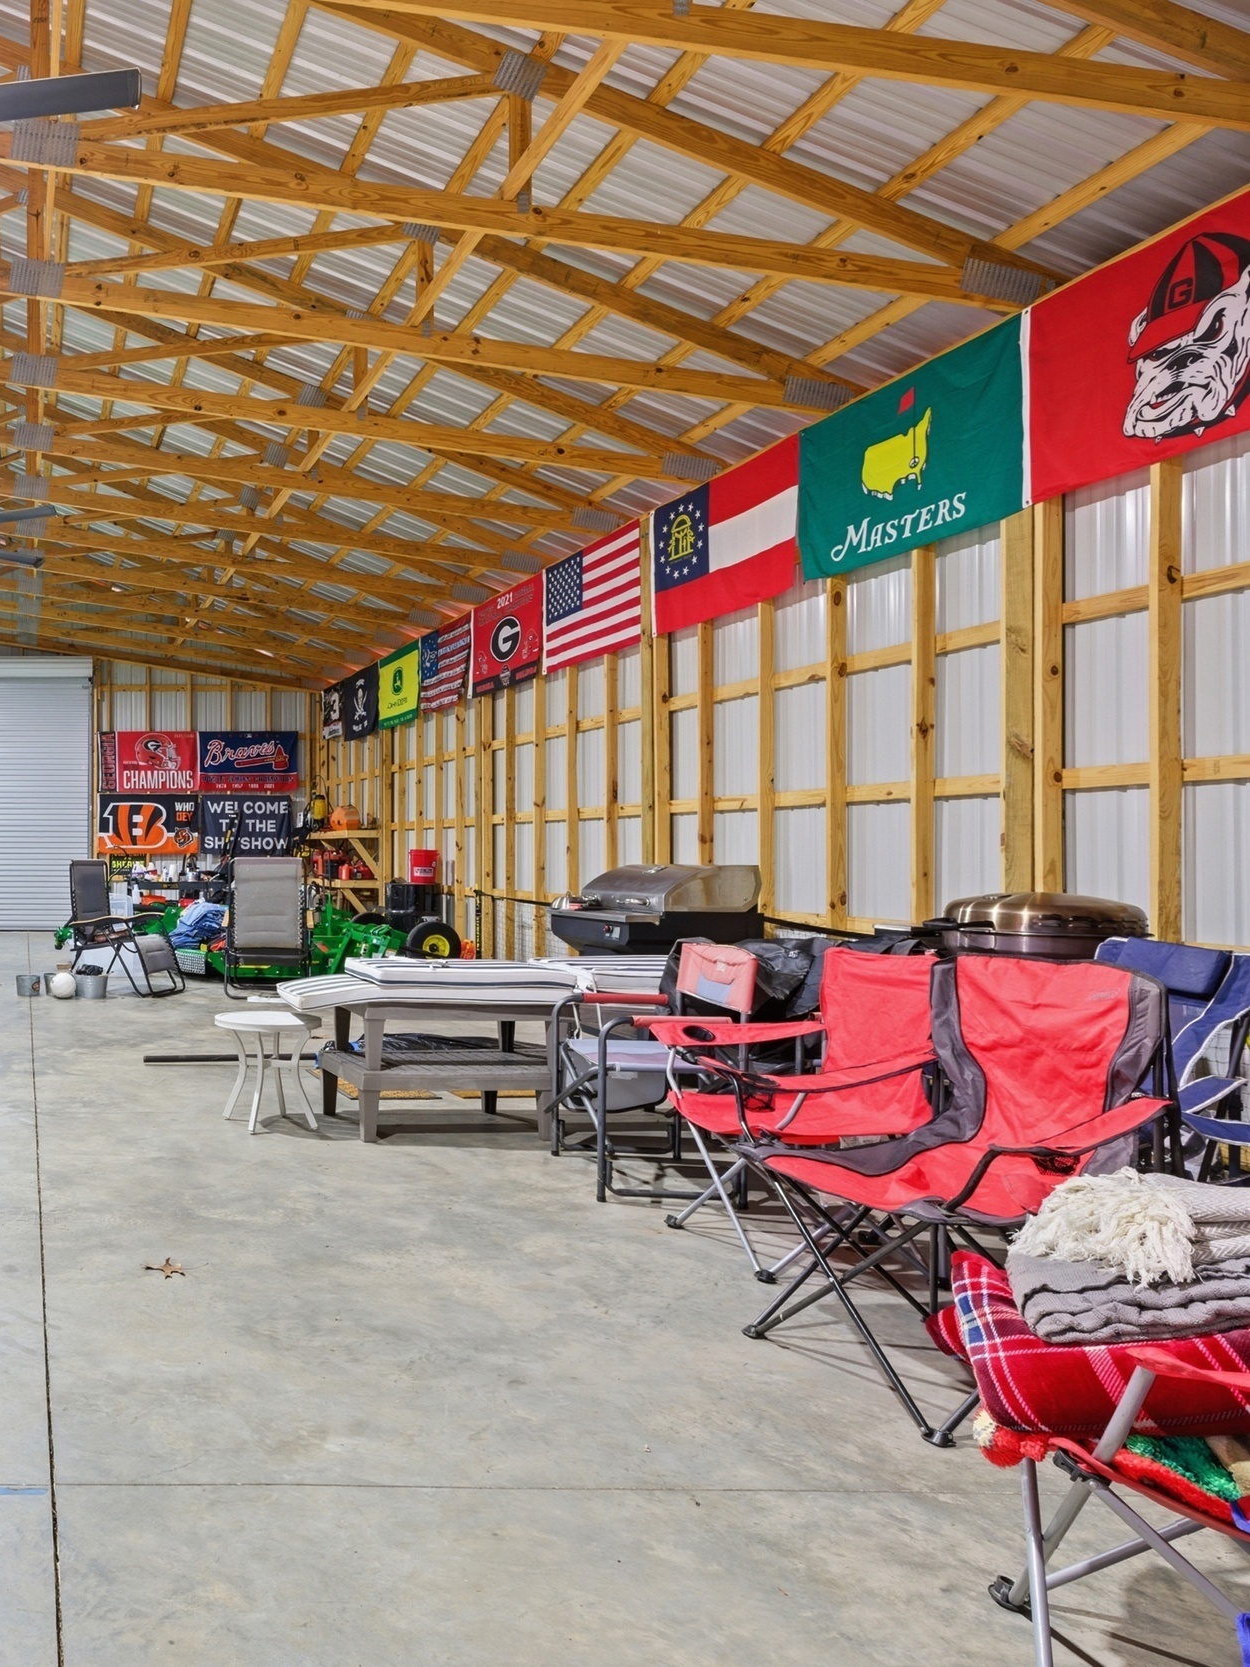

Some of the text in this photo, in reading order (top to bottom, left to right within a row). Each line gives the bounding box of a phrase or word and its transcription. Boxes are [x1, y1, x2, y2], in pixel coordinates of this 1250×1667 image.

[1167, 277, 1194, 309] G
[831, 492, 967, 562] MASTERS
[497, 592, 513, 609] 2021
[490, 616, 521, 662] G
[204, 740, 275, 767] Braves
[123, 770, 194, 789] CHAMPIONS
[174, 802, 195, 811] WHO
[176, 812, 193, 822] DEY
[219, 819, 239, 832] T
[245, 820, 276, 832] THE
